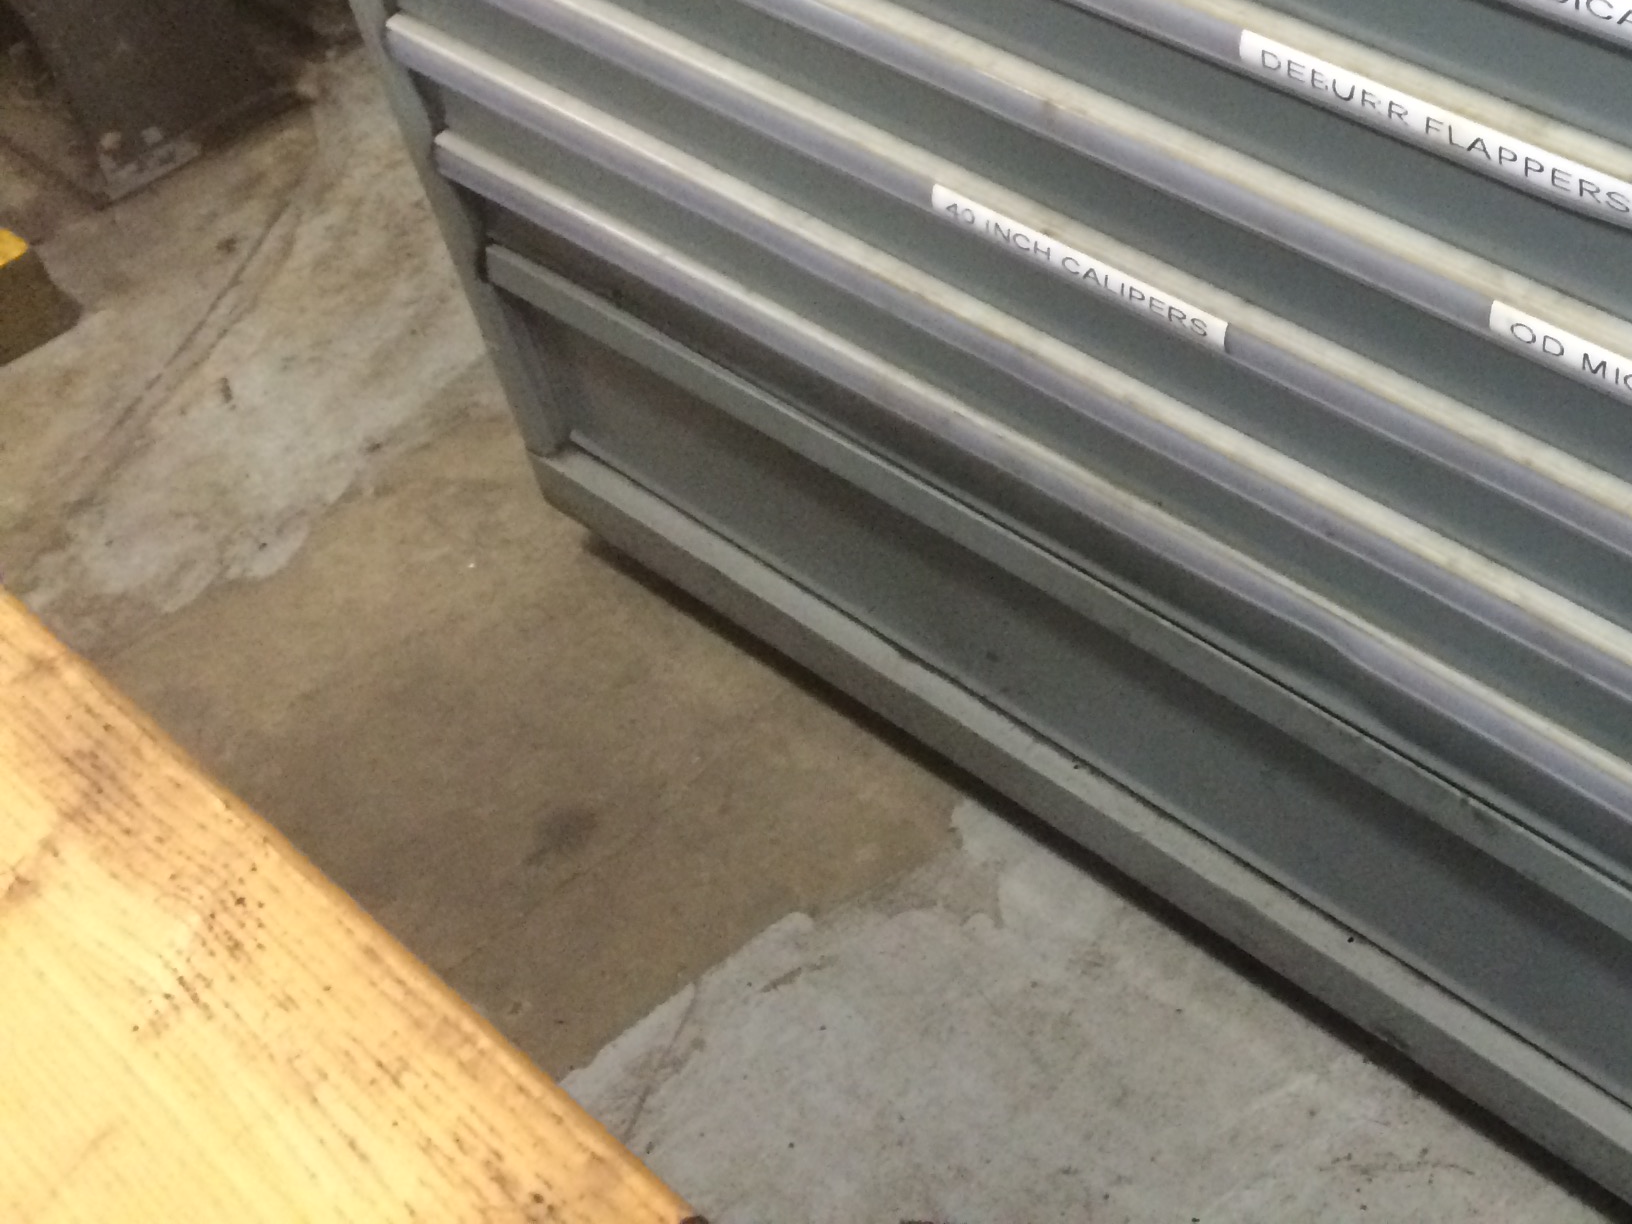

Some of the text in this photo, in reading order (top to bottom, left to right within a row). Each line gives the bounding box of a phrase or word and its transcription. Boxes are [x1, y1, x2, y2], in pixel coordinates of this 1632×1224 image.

[1424, 116, 1632, 215] FLAPPERS
[945, 202, 1208, 338] 40 INCH CALIPERS
[1510, 322, 1564, 357] OD
